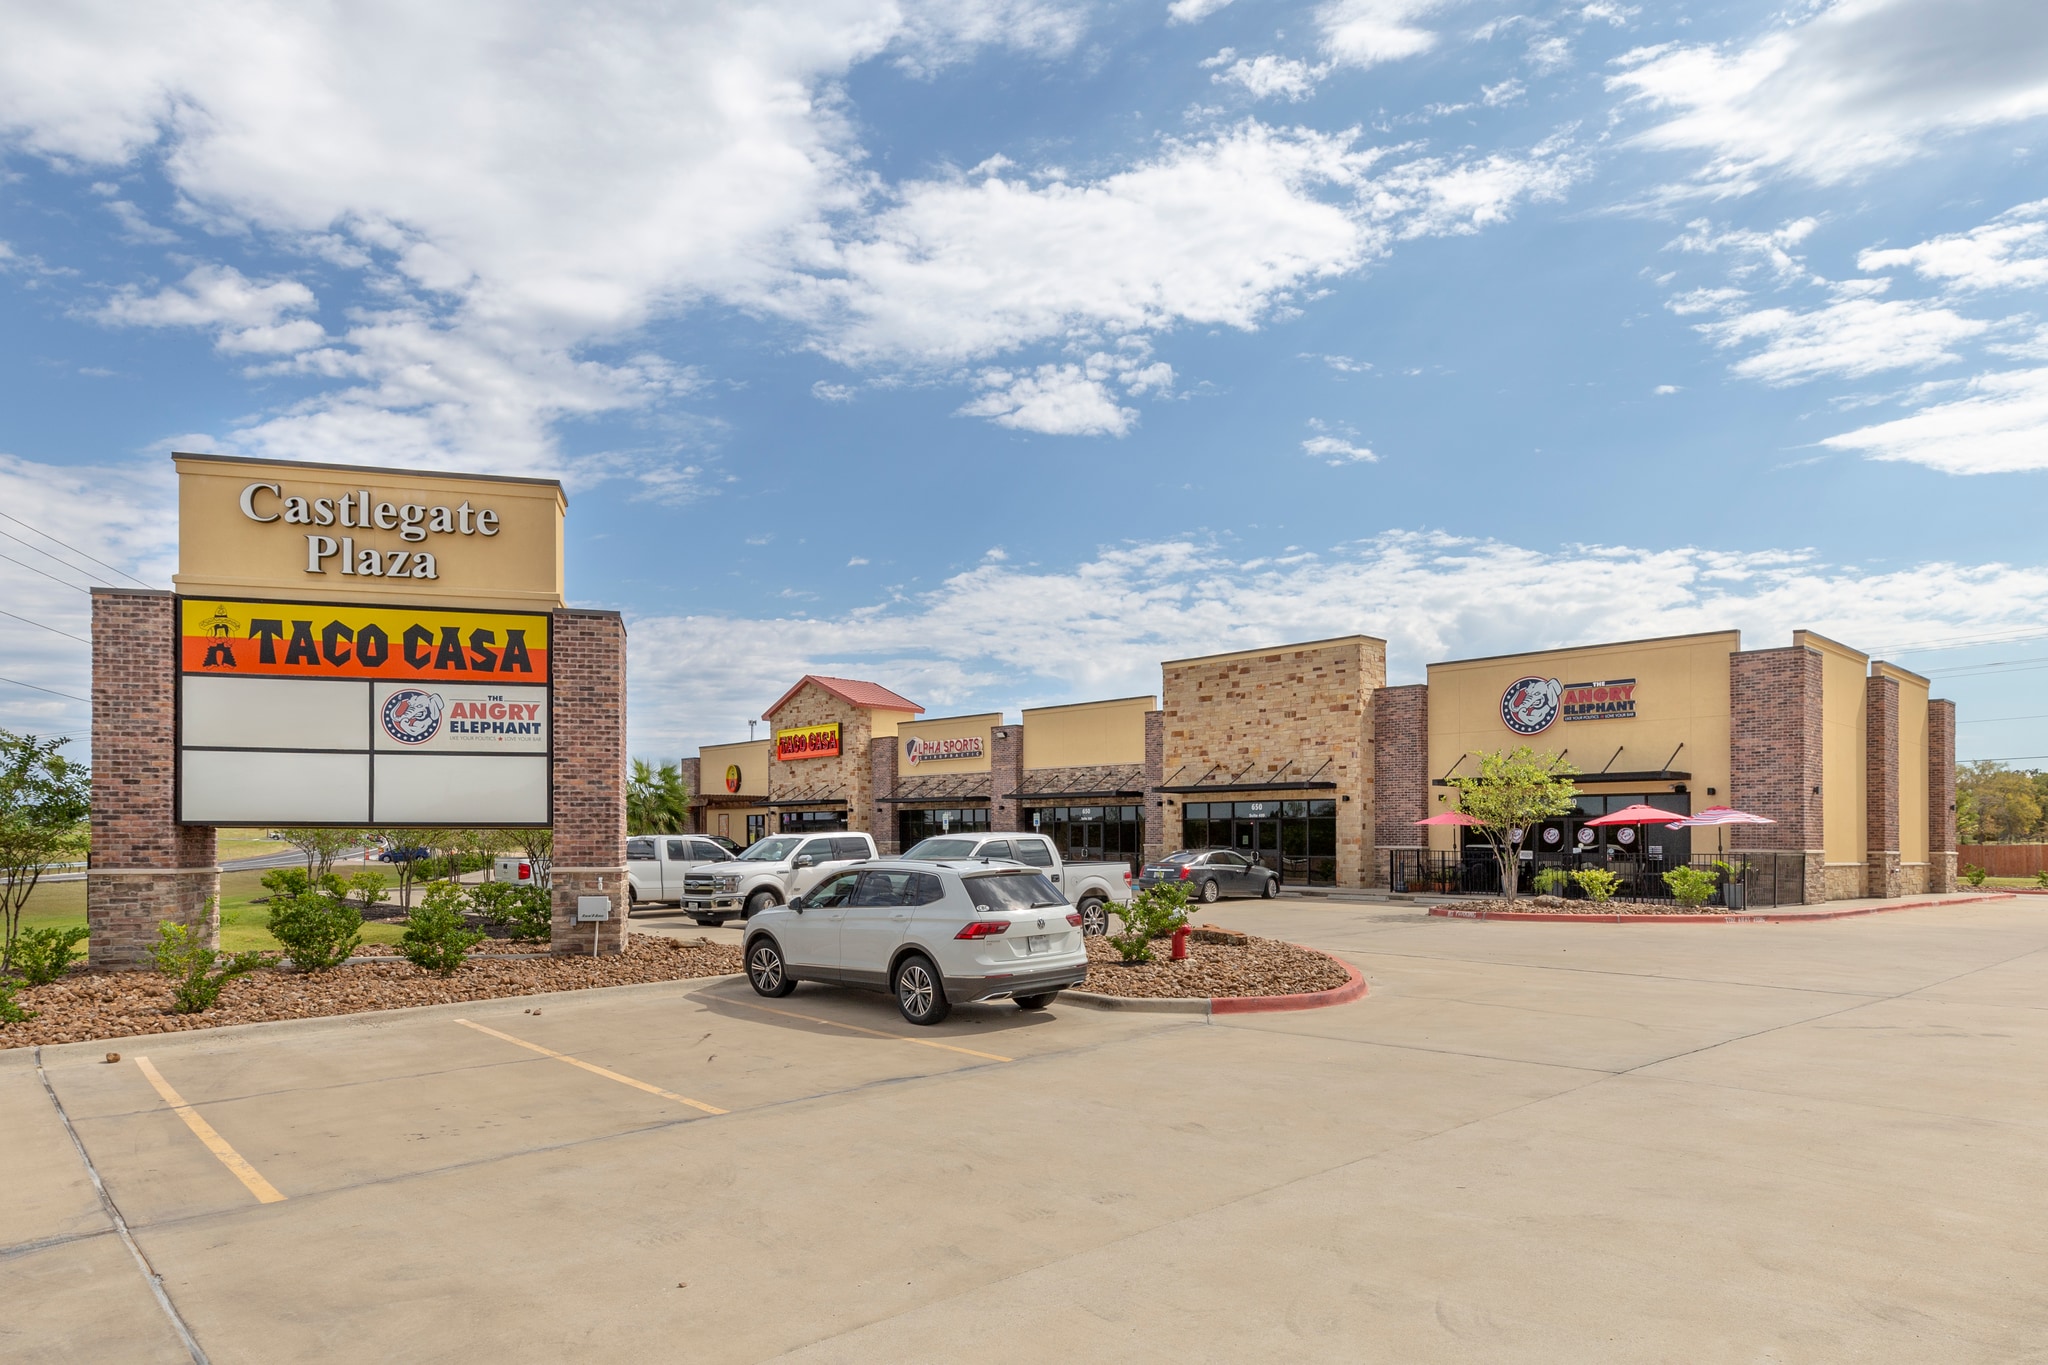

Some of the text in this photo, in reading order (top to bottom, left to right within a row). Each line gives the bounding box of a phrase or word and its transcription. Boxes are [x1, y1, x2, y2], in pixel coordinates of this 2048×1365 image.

[239, 482, 500, 542] Castlegate
[304, 534, 439, 580] Plaza
[248, 618, 533, 673] TACO CASA
[1564, 685, 1636, 704] ANGRY
[449, 702, 541, 721] ANGRY
[1564, 700, 1636, 714] ELEPHANT
[450, 720, 541, 734] ELEPHANT
[780, 730, 837, 754] TACO CASA
[943, 739, 980, 753] SPORTS
[920, 751, 980, 760] CHIROPRACTIC
[1251, 803, 1263, 811] 650
